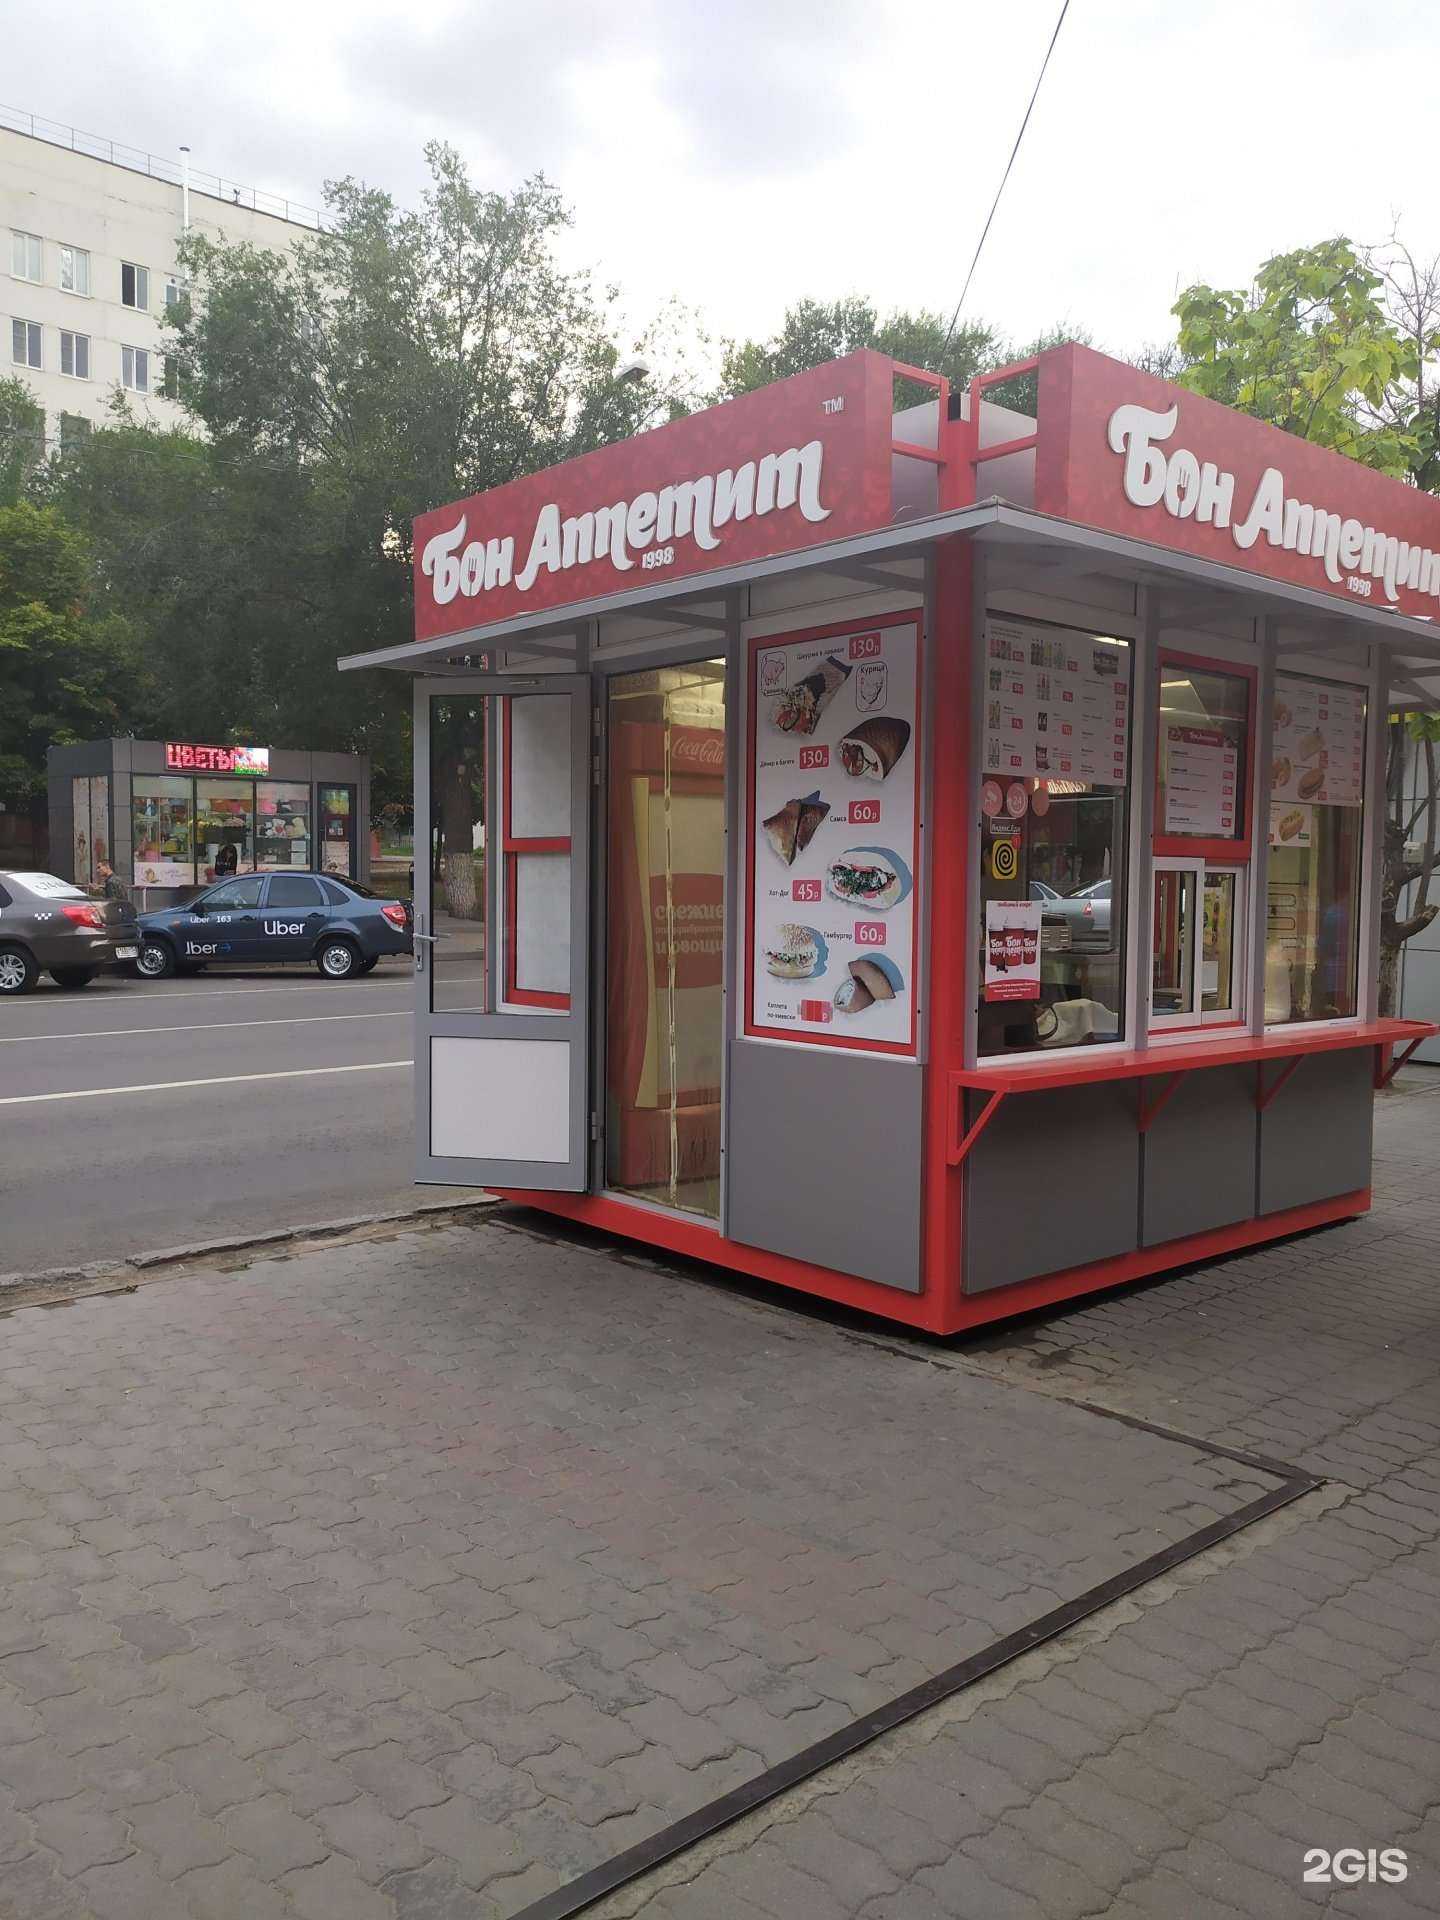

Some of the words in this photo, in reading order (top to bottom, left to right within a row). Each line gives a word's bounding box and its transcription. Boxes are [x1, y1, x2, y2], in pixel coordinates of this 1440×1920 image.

[1107, 401, 1236, 528] Бон
[421, 514, 515, 605] Бон
[514, 440, 833, 591] Аппетит
[641, 546, 675, 570] 1998
[1346, 576, 1372, 597] 1998
[167, 744, 235, 771] ЦВЕТЫ
[190, 915, 210, 924] Uber
[217, 915, 232, 923] 163
[655, 904, 723, 920] сежие
[263, 920, 306, 935] Uber
